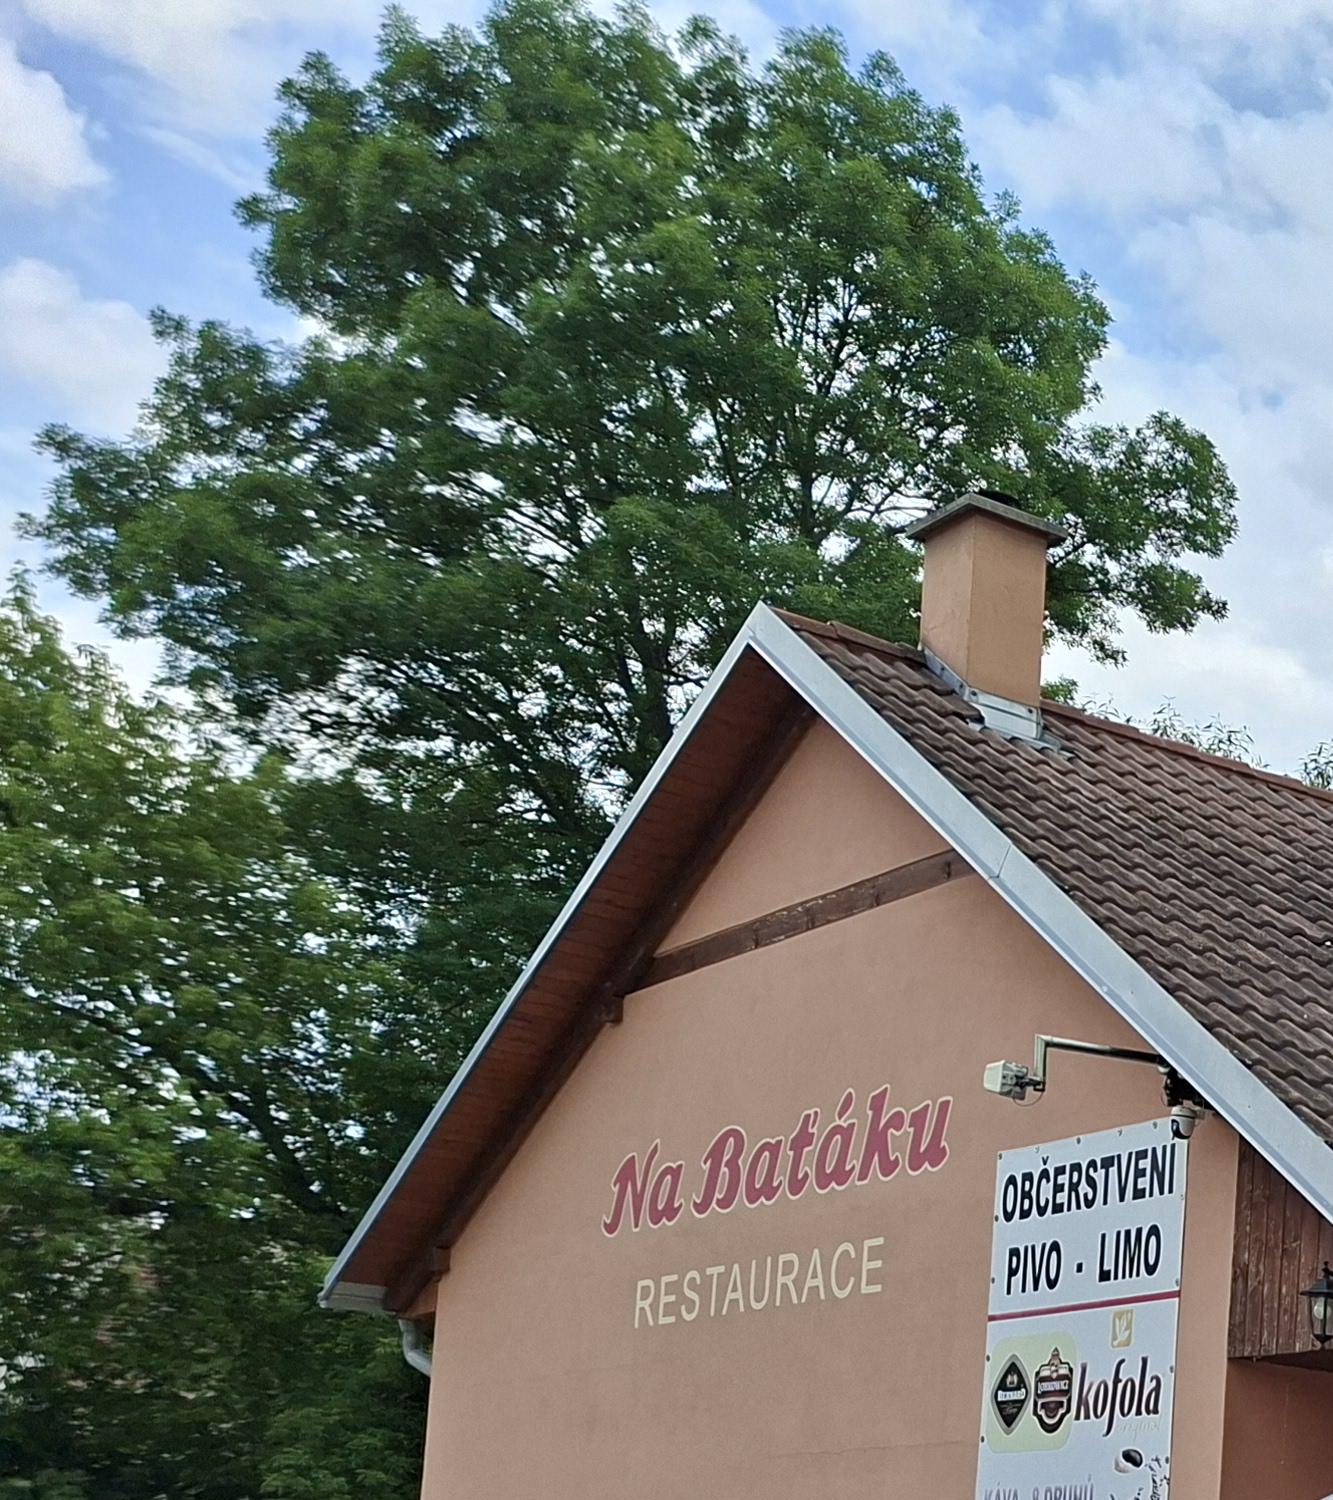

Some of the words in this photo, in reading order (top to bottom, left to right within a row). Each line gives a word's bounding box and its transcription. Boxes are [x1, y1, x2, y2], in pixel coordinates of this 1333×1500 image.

[603, 1139, 685, 1237] Na
[691, 1083, 953, 1218] Baťáku
[1002, 1136, 1176, 1223] OBČERSTVENÍ
[634, 1237, 885, 1328] RESTAURACE
[1006, 1240, 1062, 1295] PIVO
[1098, 1224, 1162, 1282] LIMO
[1074, 1356, 1162, 1437] kofola
